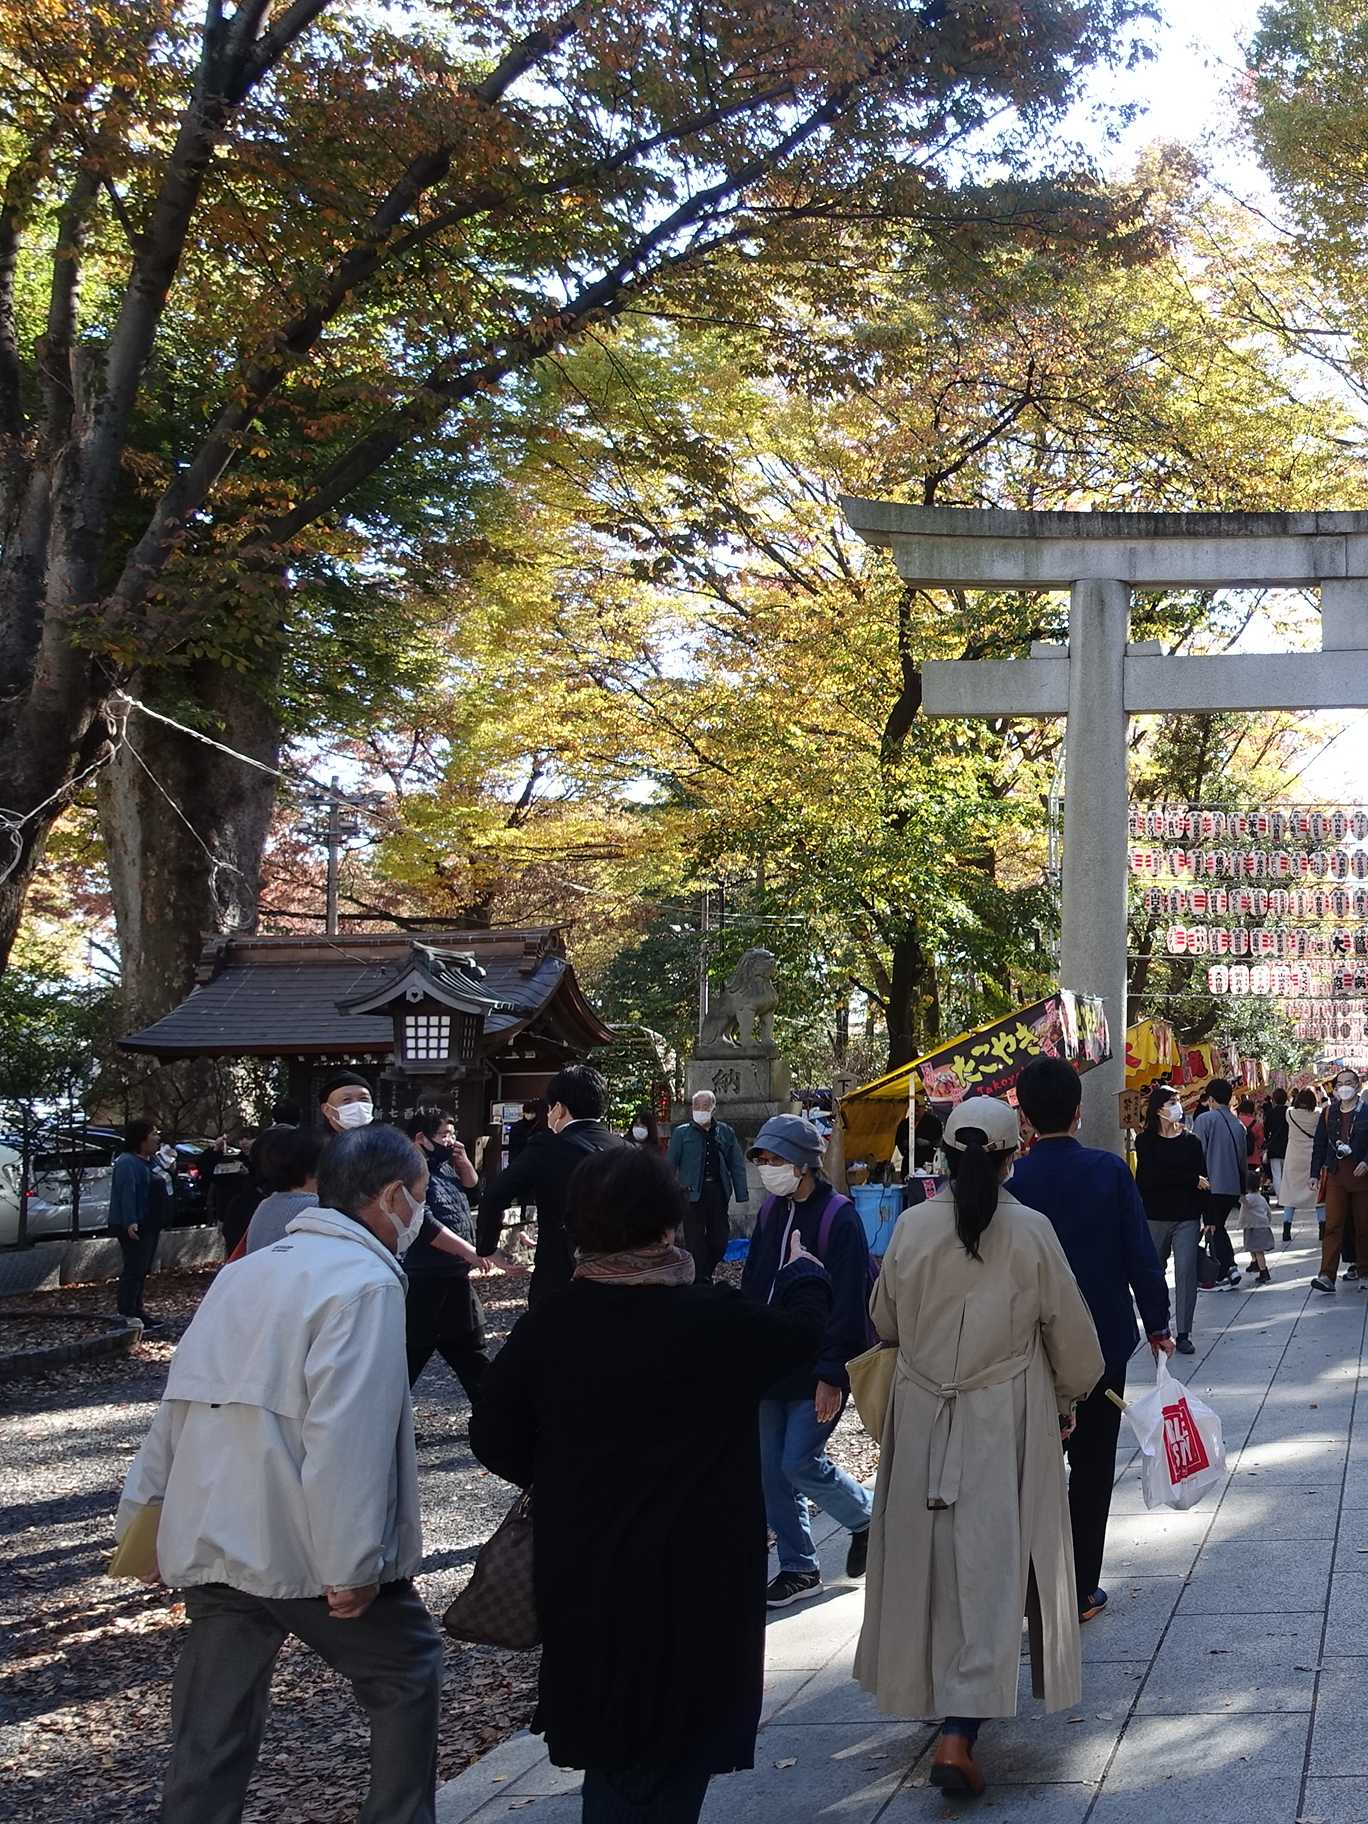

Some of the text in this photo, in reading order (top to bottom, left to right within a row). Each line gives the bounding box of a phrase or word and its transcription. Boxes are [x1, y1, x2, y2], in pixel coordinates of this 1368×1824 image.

[951, 1022, 1041, 1088] たこやき
[711, 1068, 741, 1094] 納
